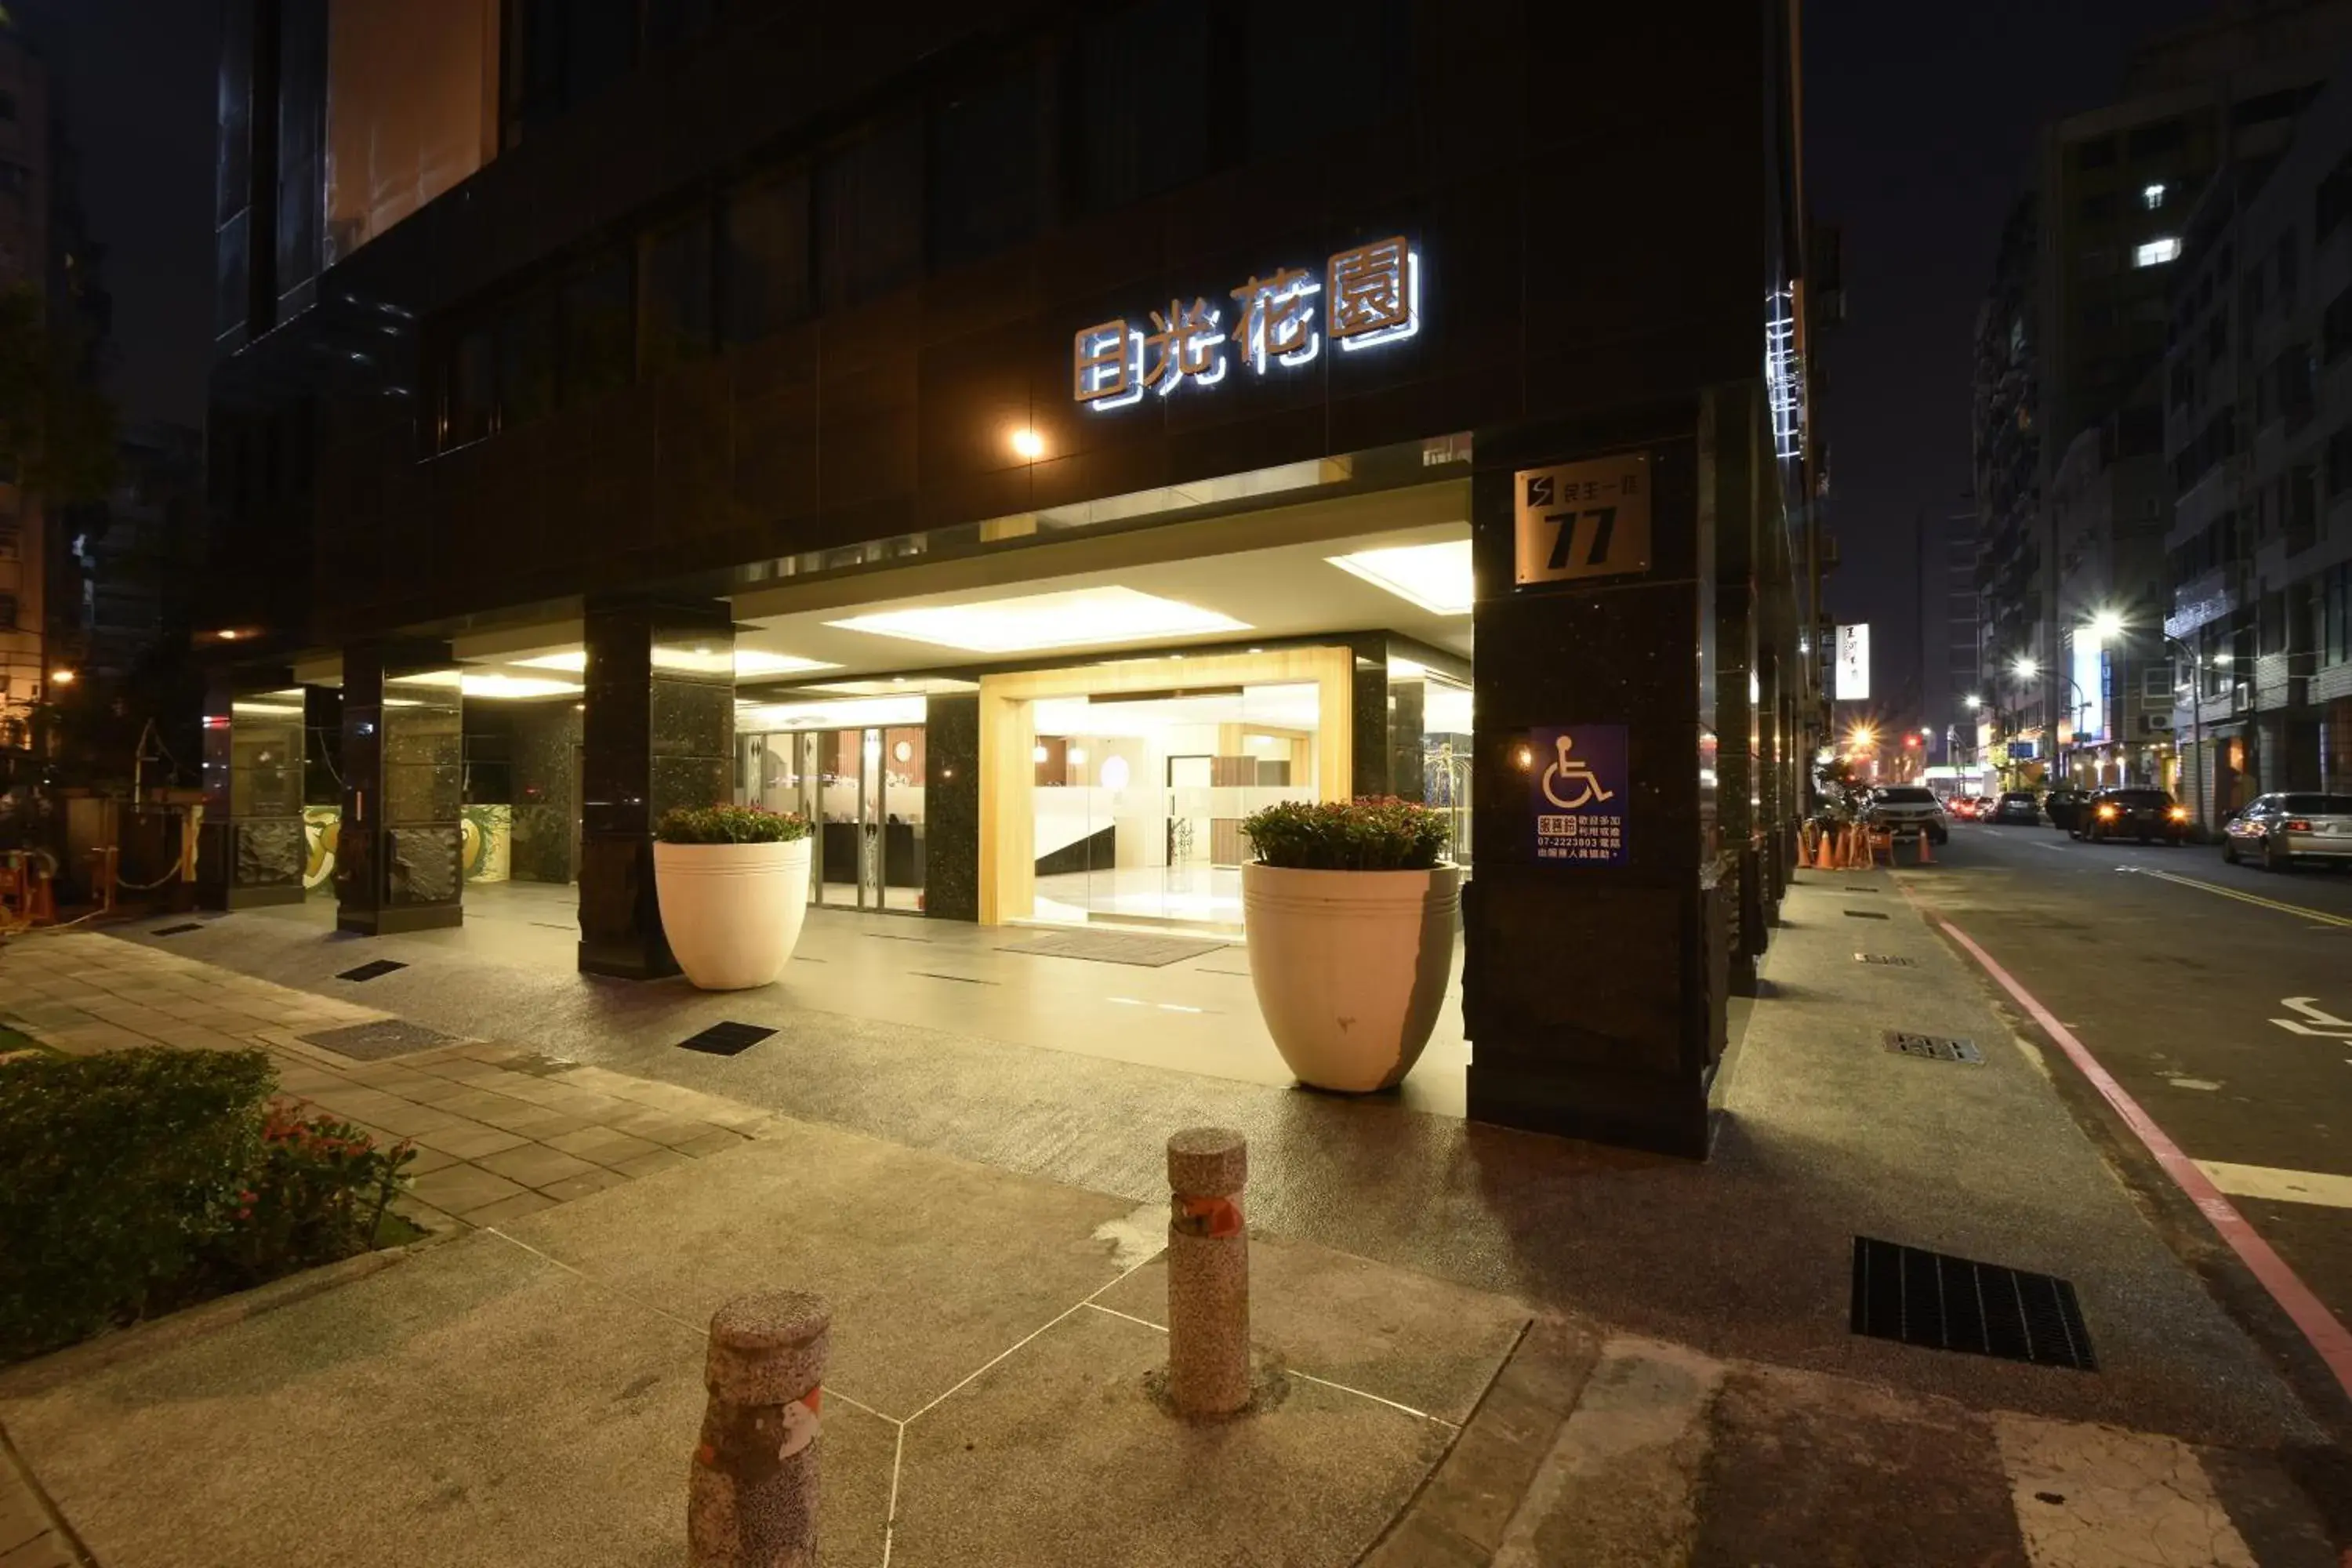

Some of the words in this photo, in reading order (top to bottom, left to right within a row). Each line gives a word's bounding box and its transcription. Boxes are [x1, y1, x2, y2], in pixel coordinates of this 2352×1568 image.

[1074, 235, 1417, 411] 日光花園
[1544, 506, 1617, 570] 77
